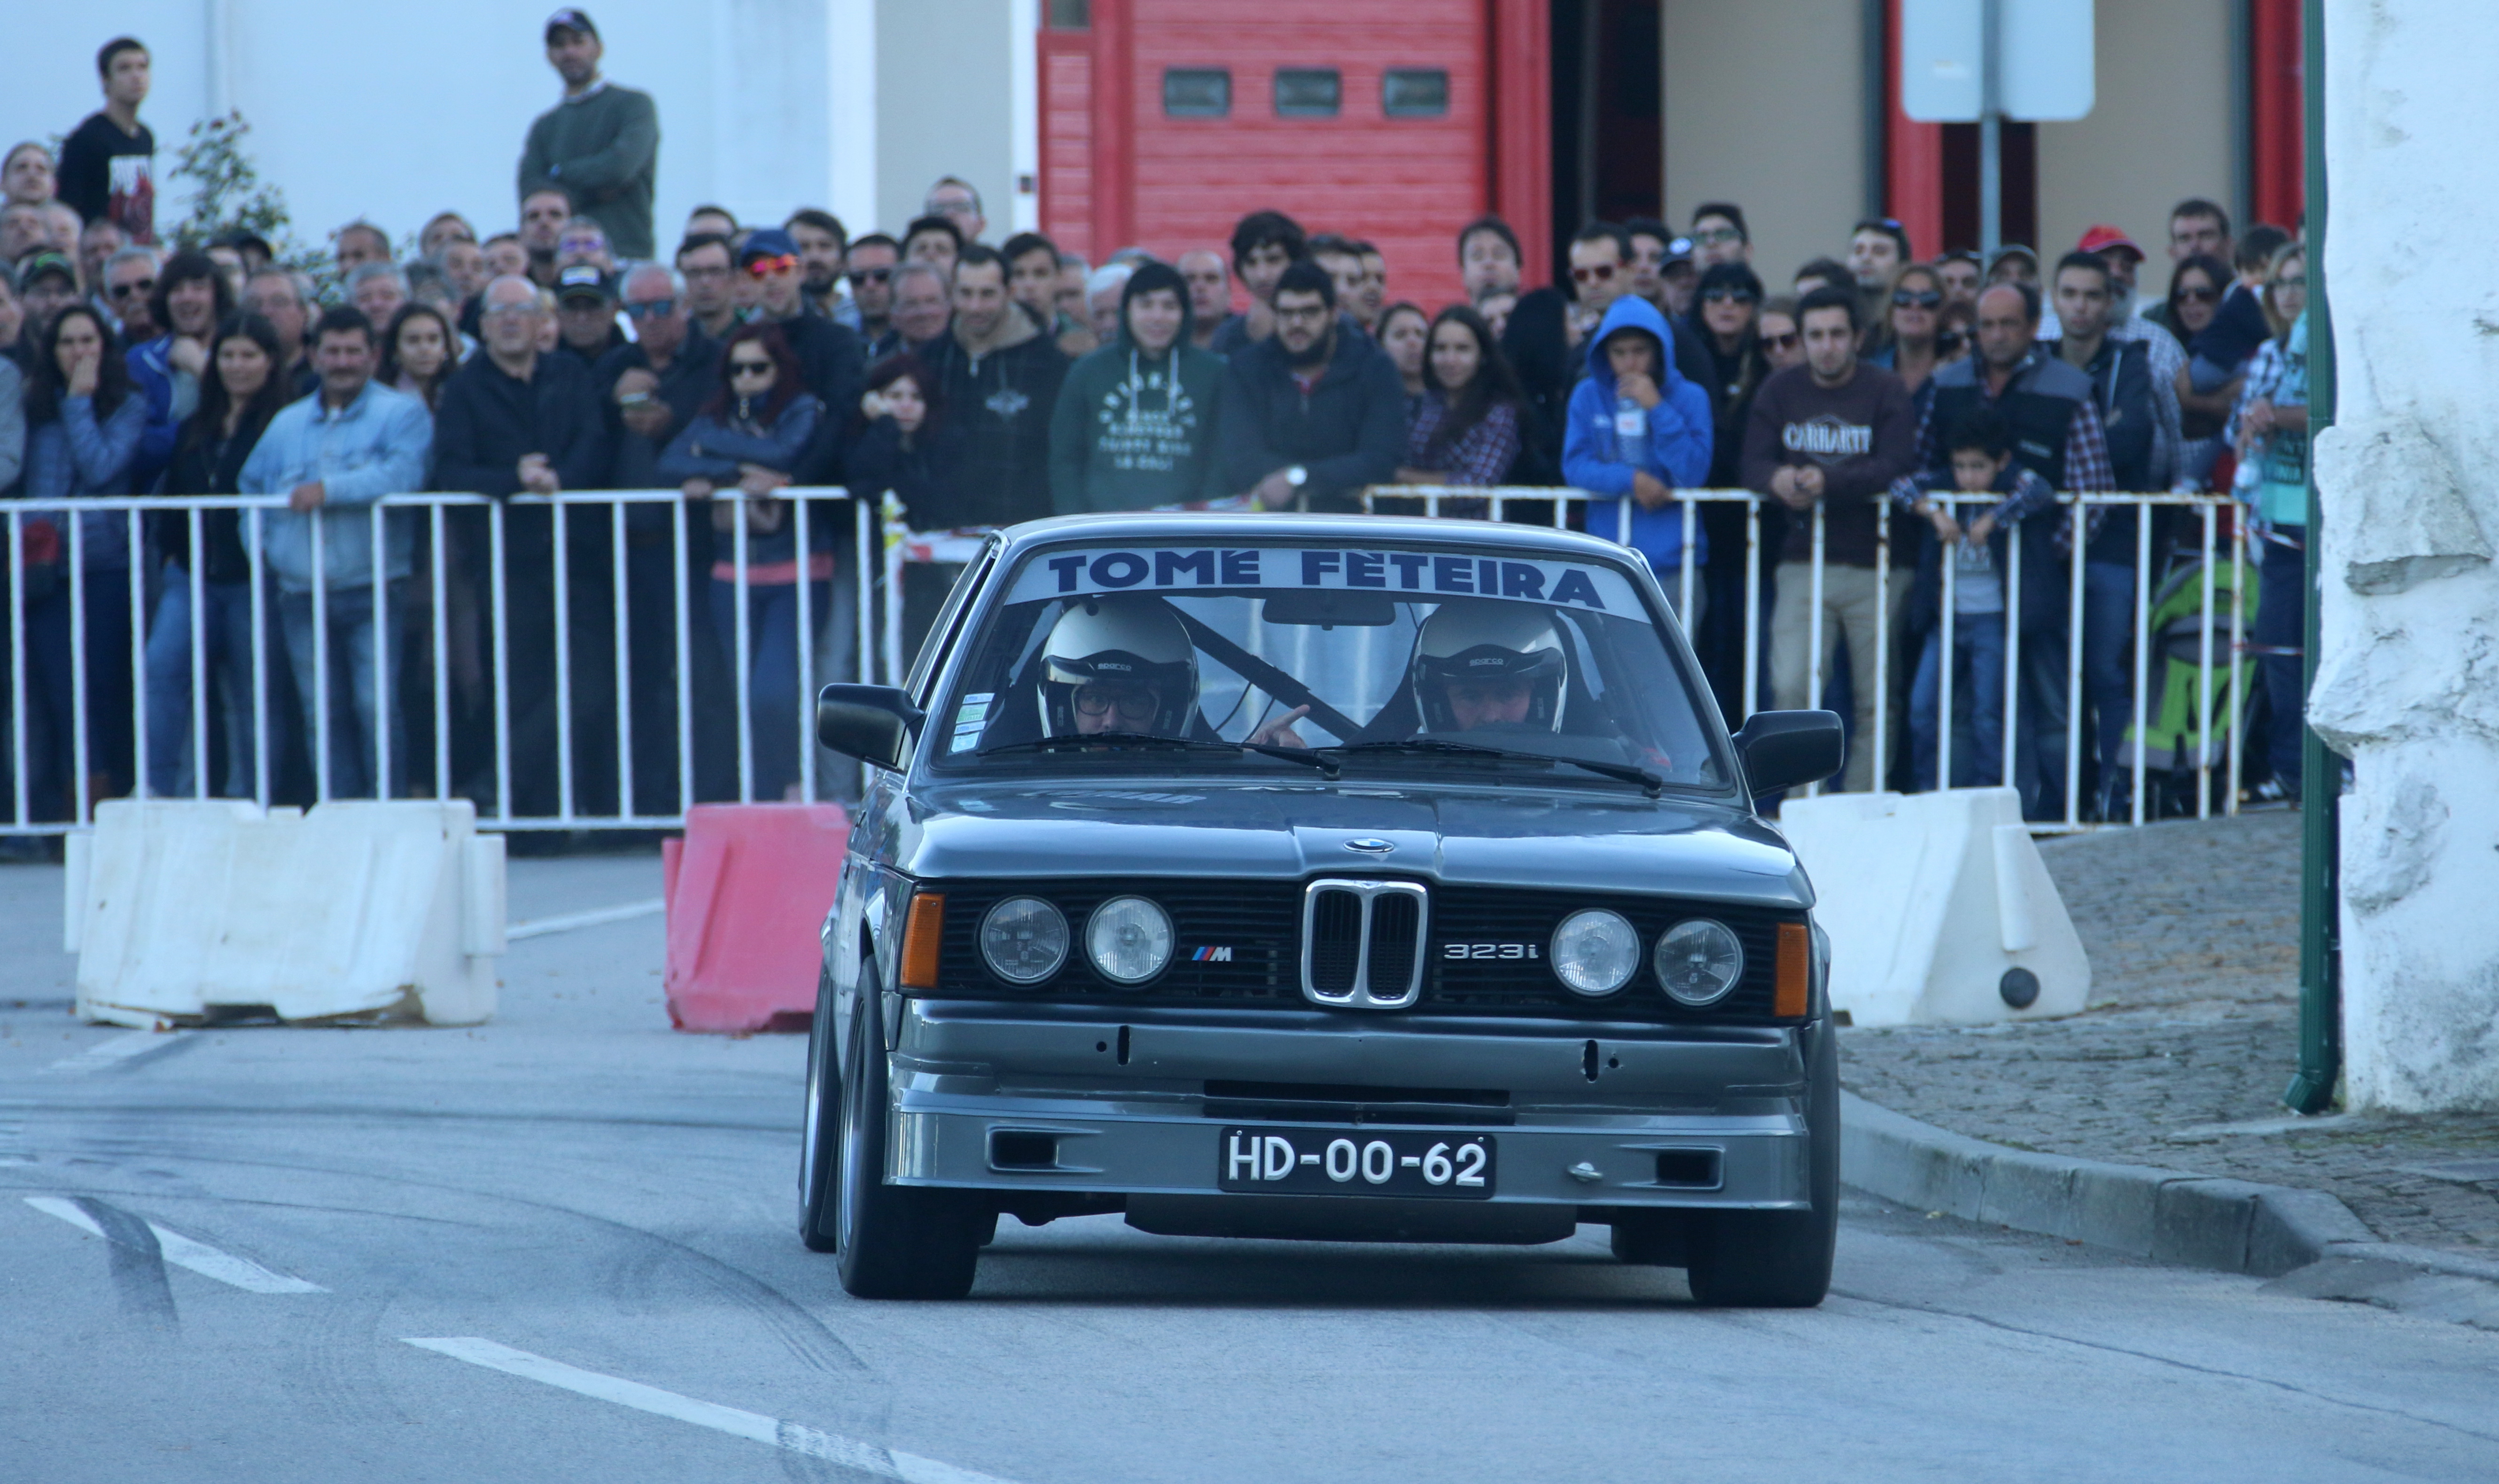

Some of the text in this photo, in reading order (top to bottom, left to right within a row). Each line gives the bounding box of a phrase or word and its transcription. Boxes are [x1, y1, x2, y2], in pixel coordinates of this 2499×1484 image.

[1049, 550, 1261, 593] TOMÉ
[1208, 947, 1231, 962] M
[1444, 944, 1539, 959] 323i
[1229, 1136, 1487, 1187] HD-00-62
